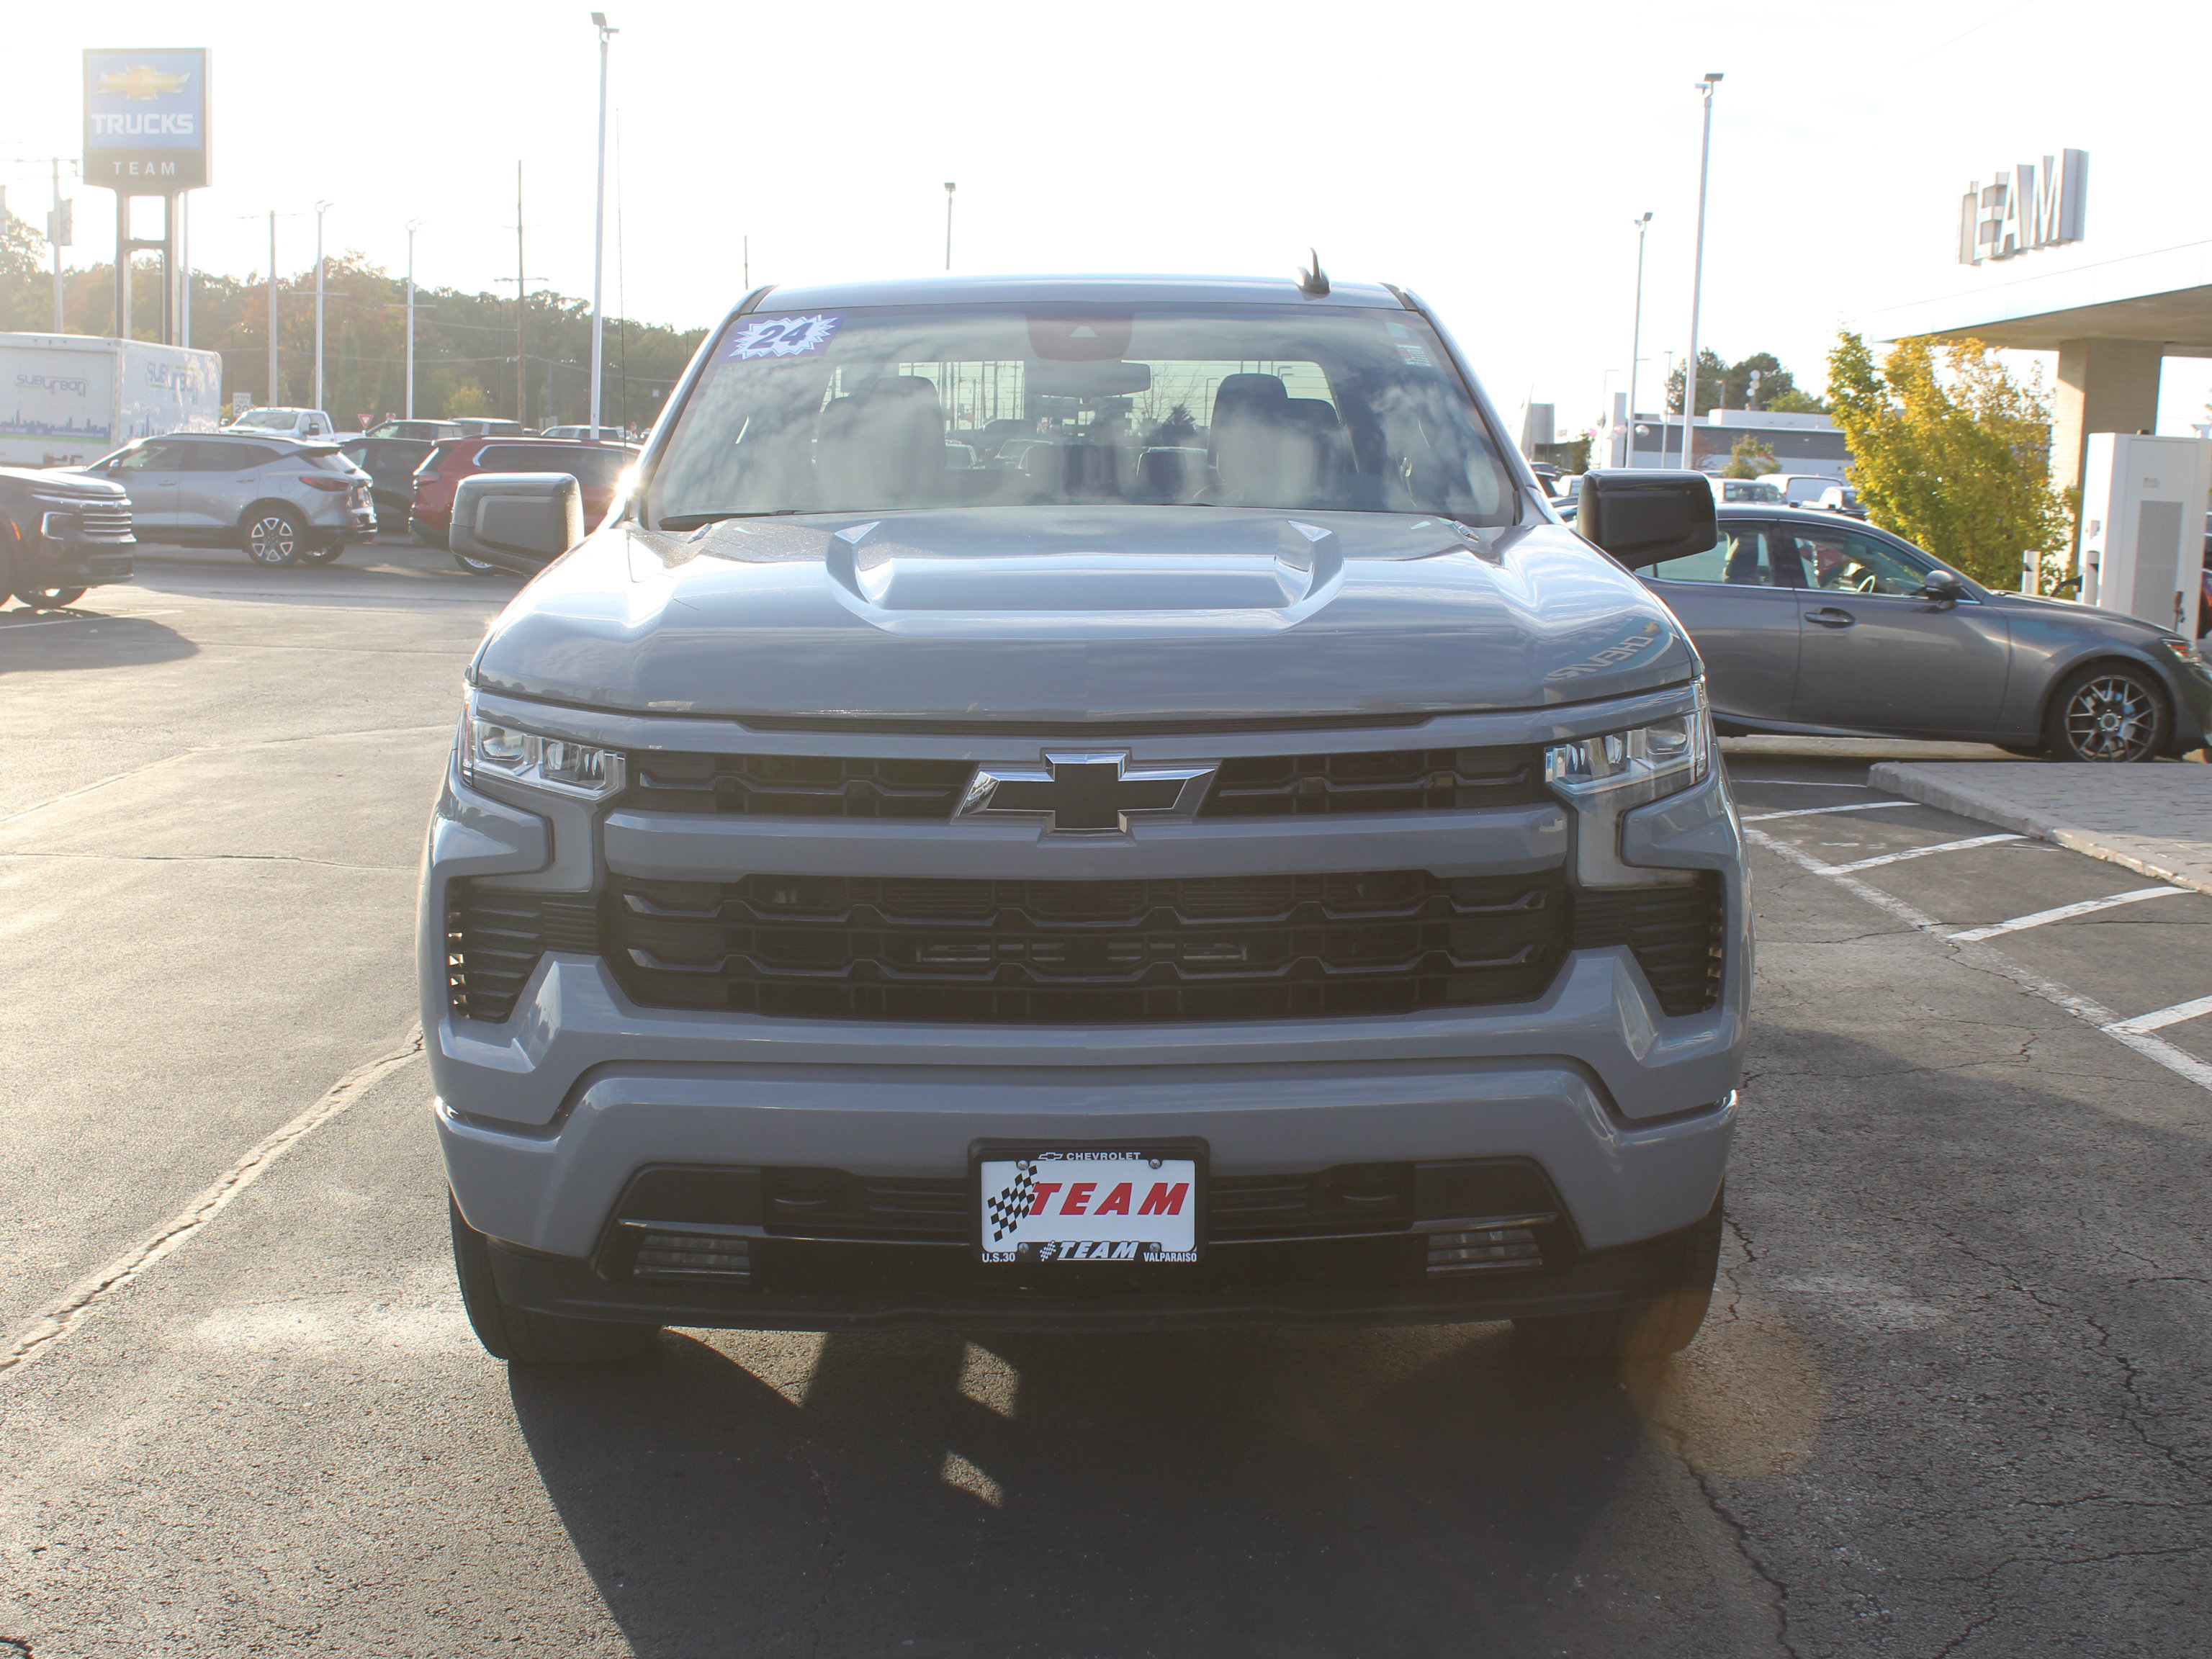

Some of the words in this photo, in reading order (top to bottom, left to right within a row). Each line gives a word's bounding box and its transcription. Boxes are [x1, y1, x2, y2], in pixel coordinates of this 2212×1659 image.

[91, 114, 194, 134] TRUCKS
[112, 161, 175, 175] TEAM
[747, 322, 814, 350] 24
[235, 405, 249, 413] 20
[1029, 1182, 1190, 1215] TEAM
[1057, 1241, 1140, 1259] TEAM
[1143, 1252, 1197, 1262] VALPARAISO
